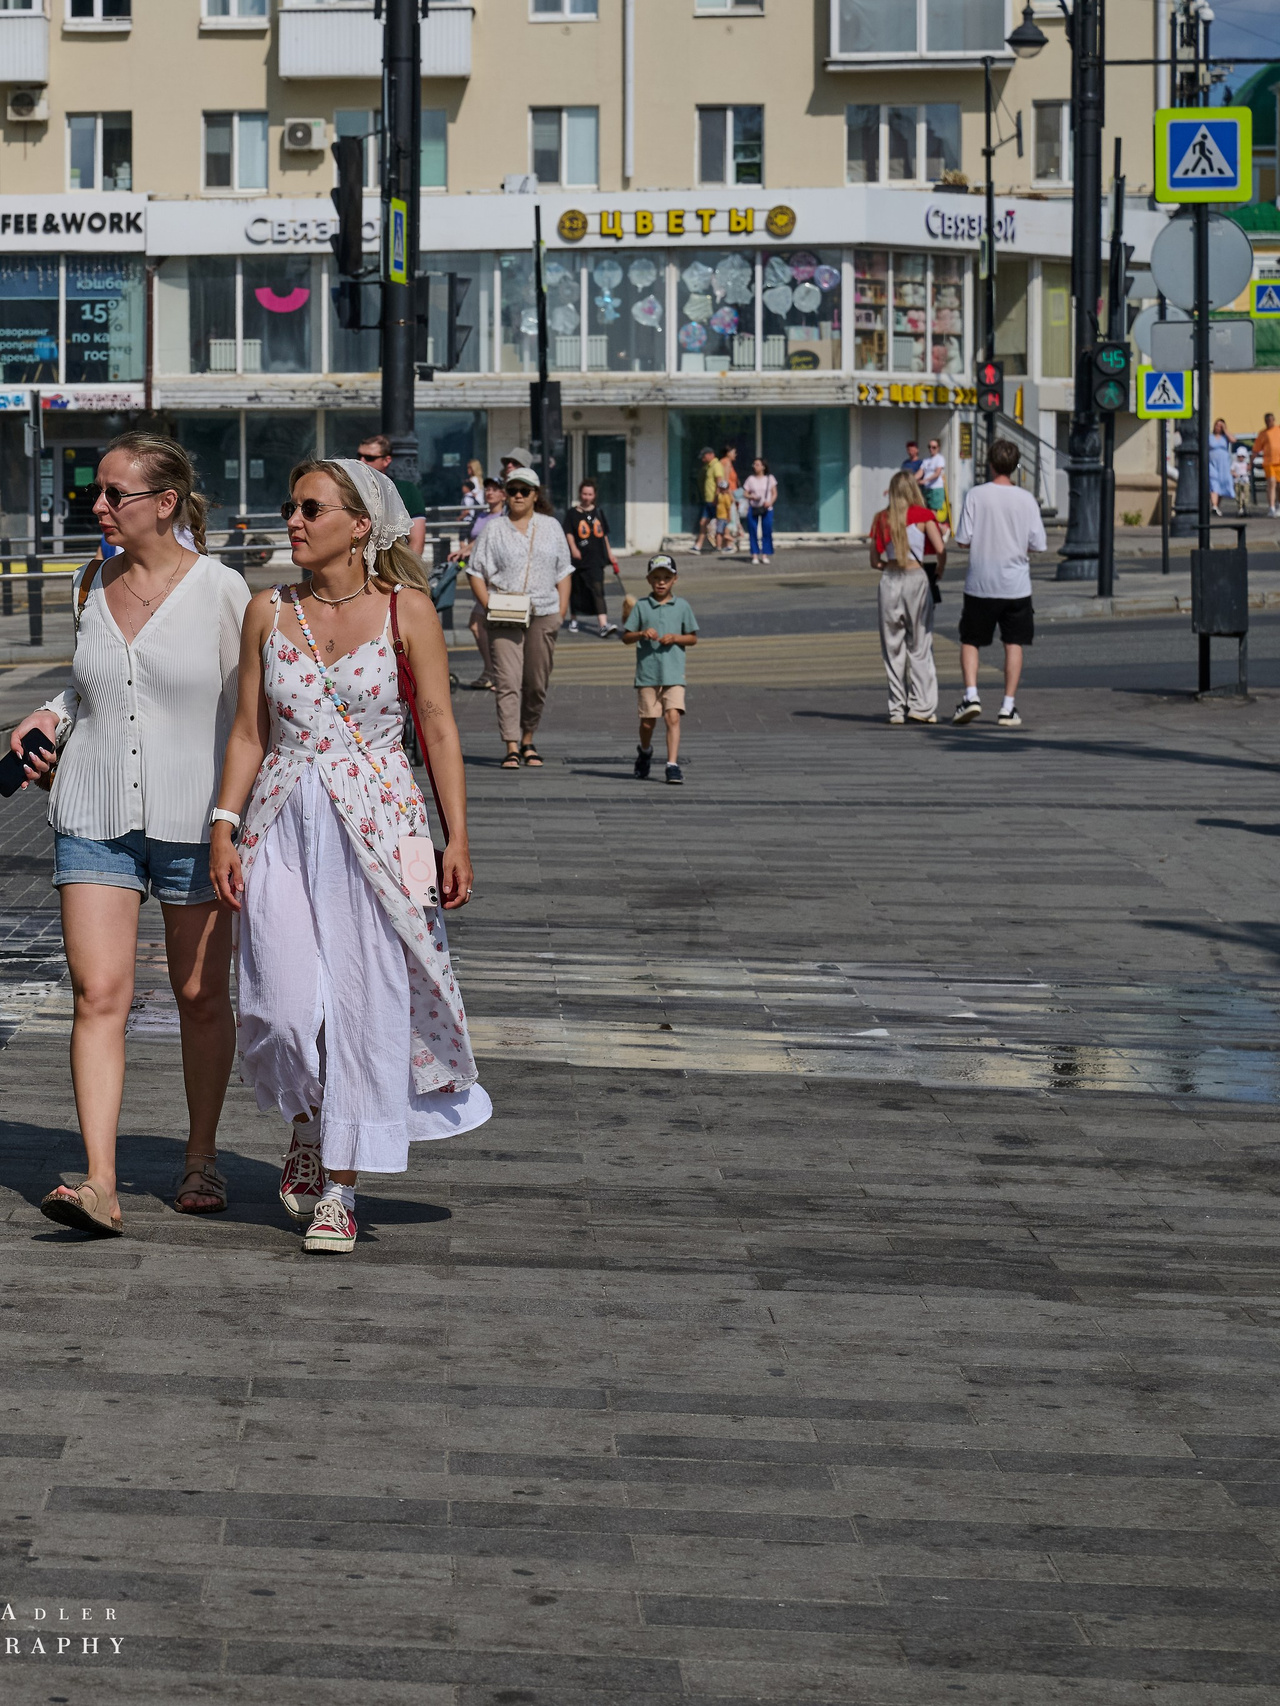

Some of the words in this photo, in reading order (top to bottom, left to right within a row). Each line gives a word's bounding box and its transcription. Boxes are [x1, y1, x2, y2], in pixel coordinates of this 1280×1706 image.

[600, 208, 755, 239] ЦВЕТЫ
[71, 332, 91, 344] по
[0, 354, 41, 364] аренда
[1102, 349, 1126, 369] 45
